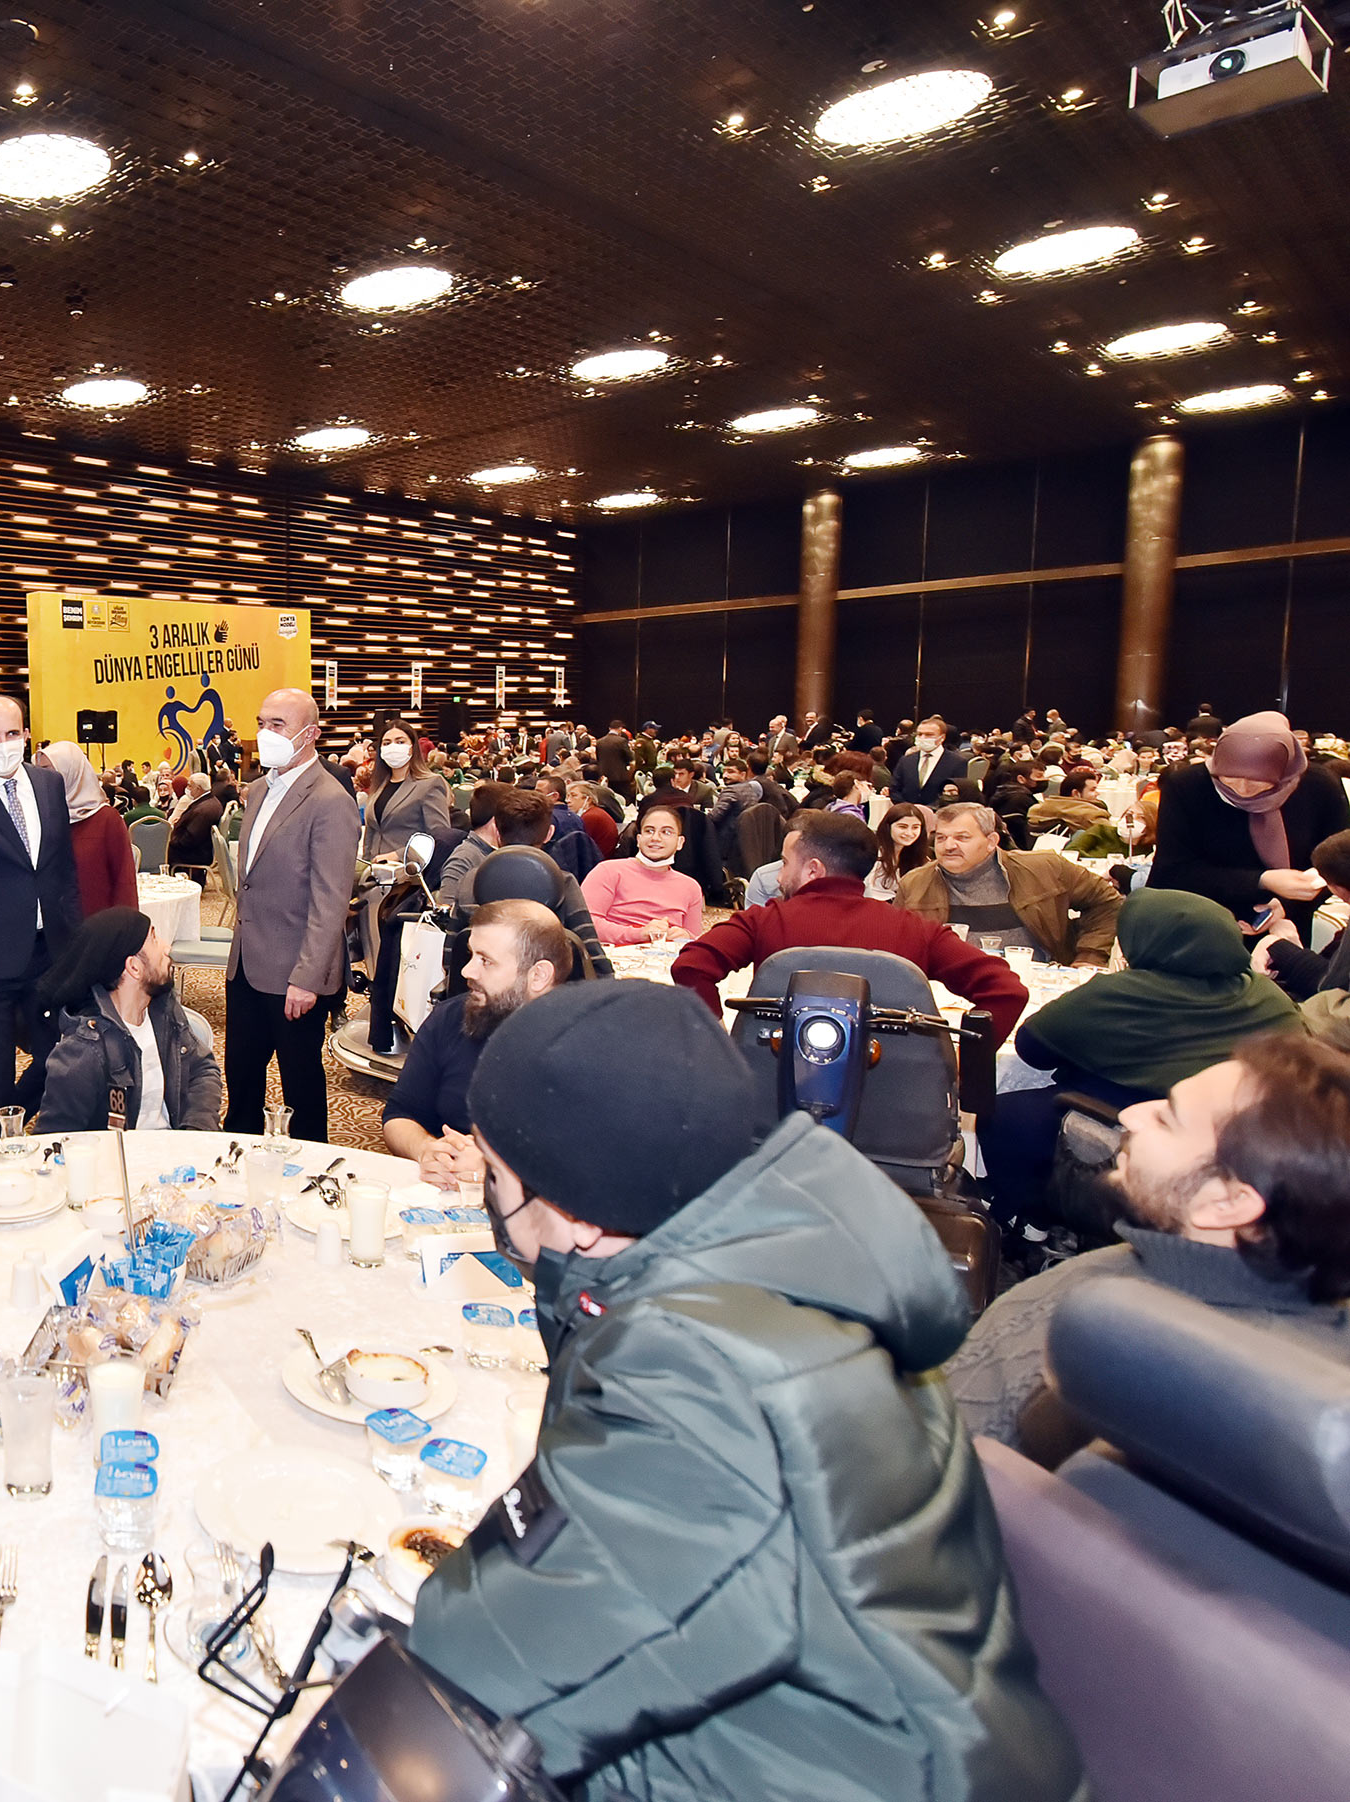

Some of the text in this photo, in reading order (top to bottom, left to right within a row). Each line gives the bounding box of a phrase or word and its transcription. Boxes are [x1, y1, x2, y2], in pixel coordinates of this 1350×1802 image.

[150, 622, 210, 649] 3 ARALIK
[94, 643, 260, 684] DÜNYA ENGELLİLER GÜNÜ
[110, 1089, 125, 1113] 68
